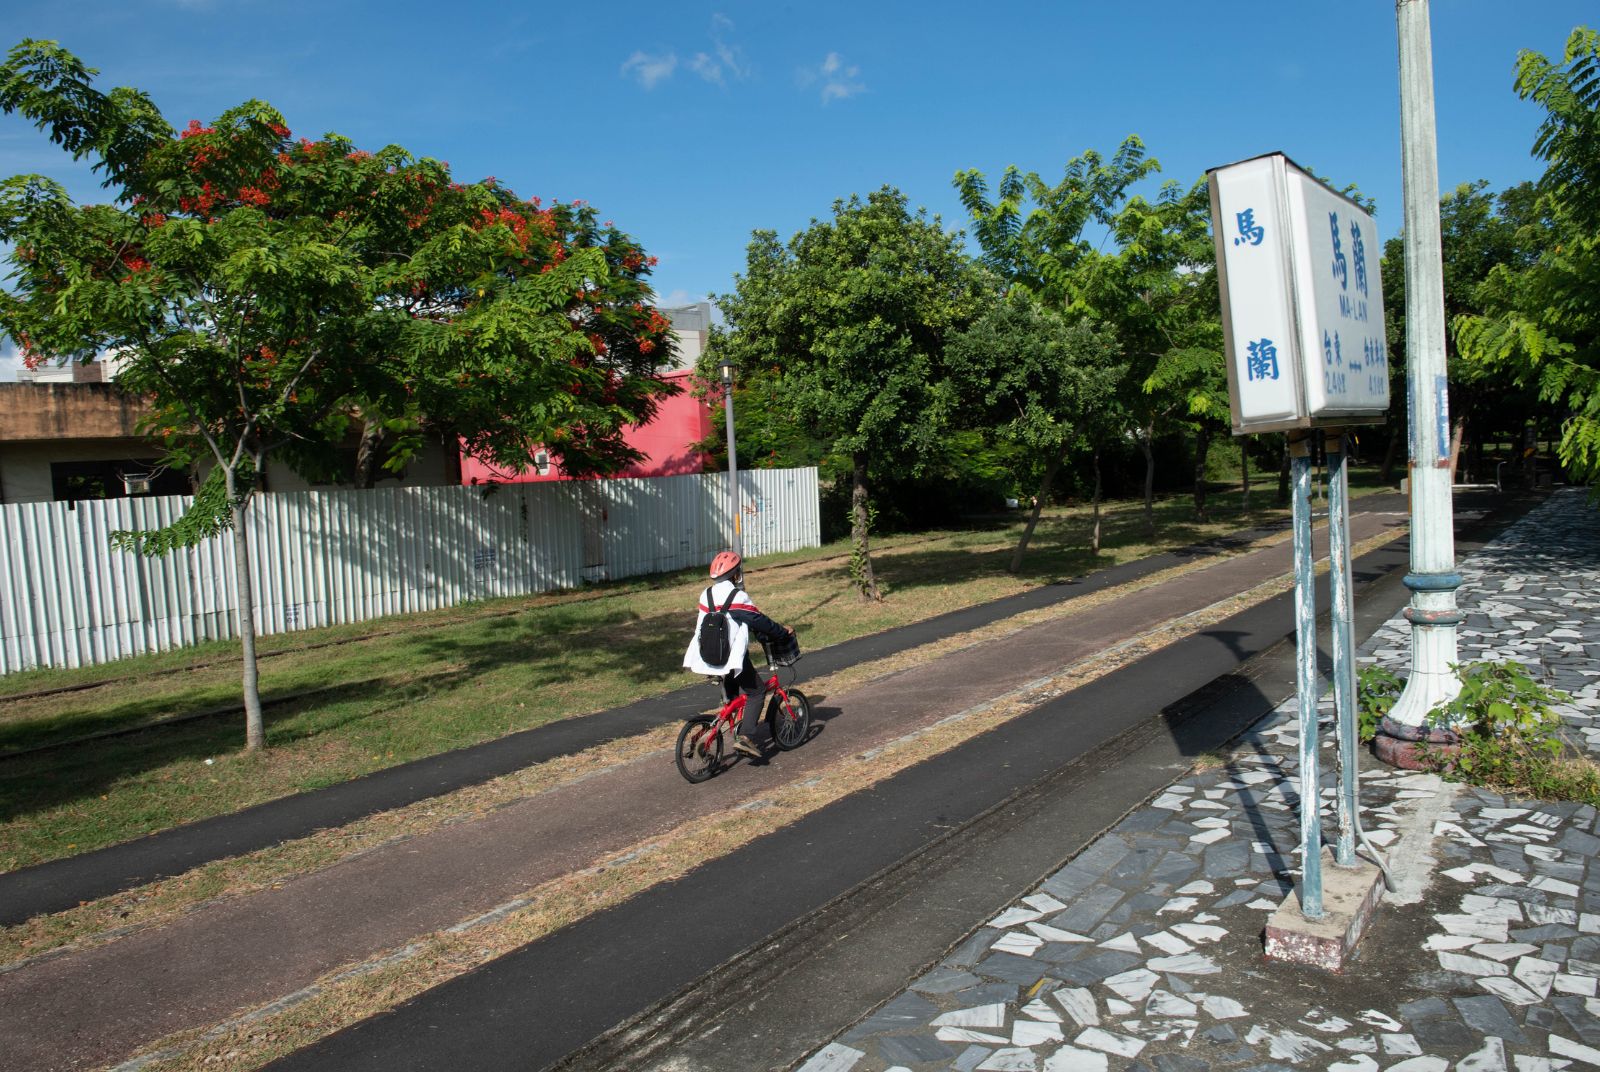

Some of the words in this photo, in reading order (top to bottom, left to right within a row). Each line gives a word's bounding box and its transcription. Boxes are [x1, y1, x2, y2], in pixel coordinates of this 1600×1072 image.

[1234, 208, 1279, 381] 馬蘭
[1328, 211, 1368, 299] 馬蘭
[1339, 294, 1368, 323] MA-LAN
